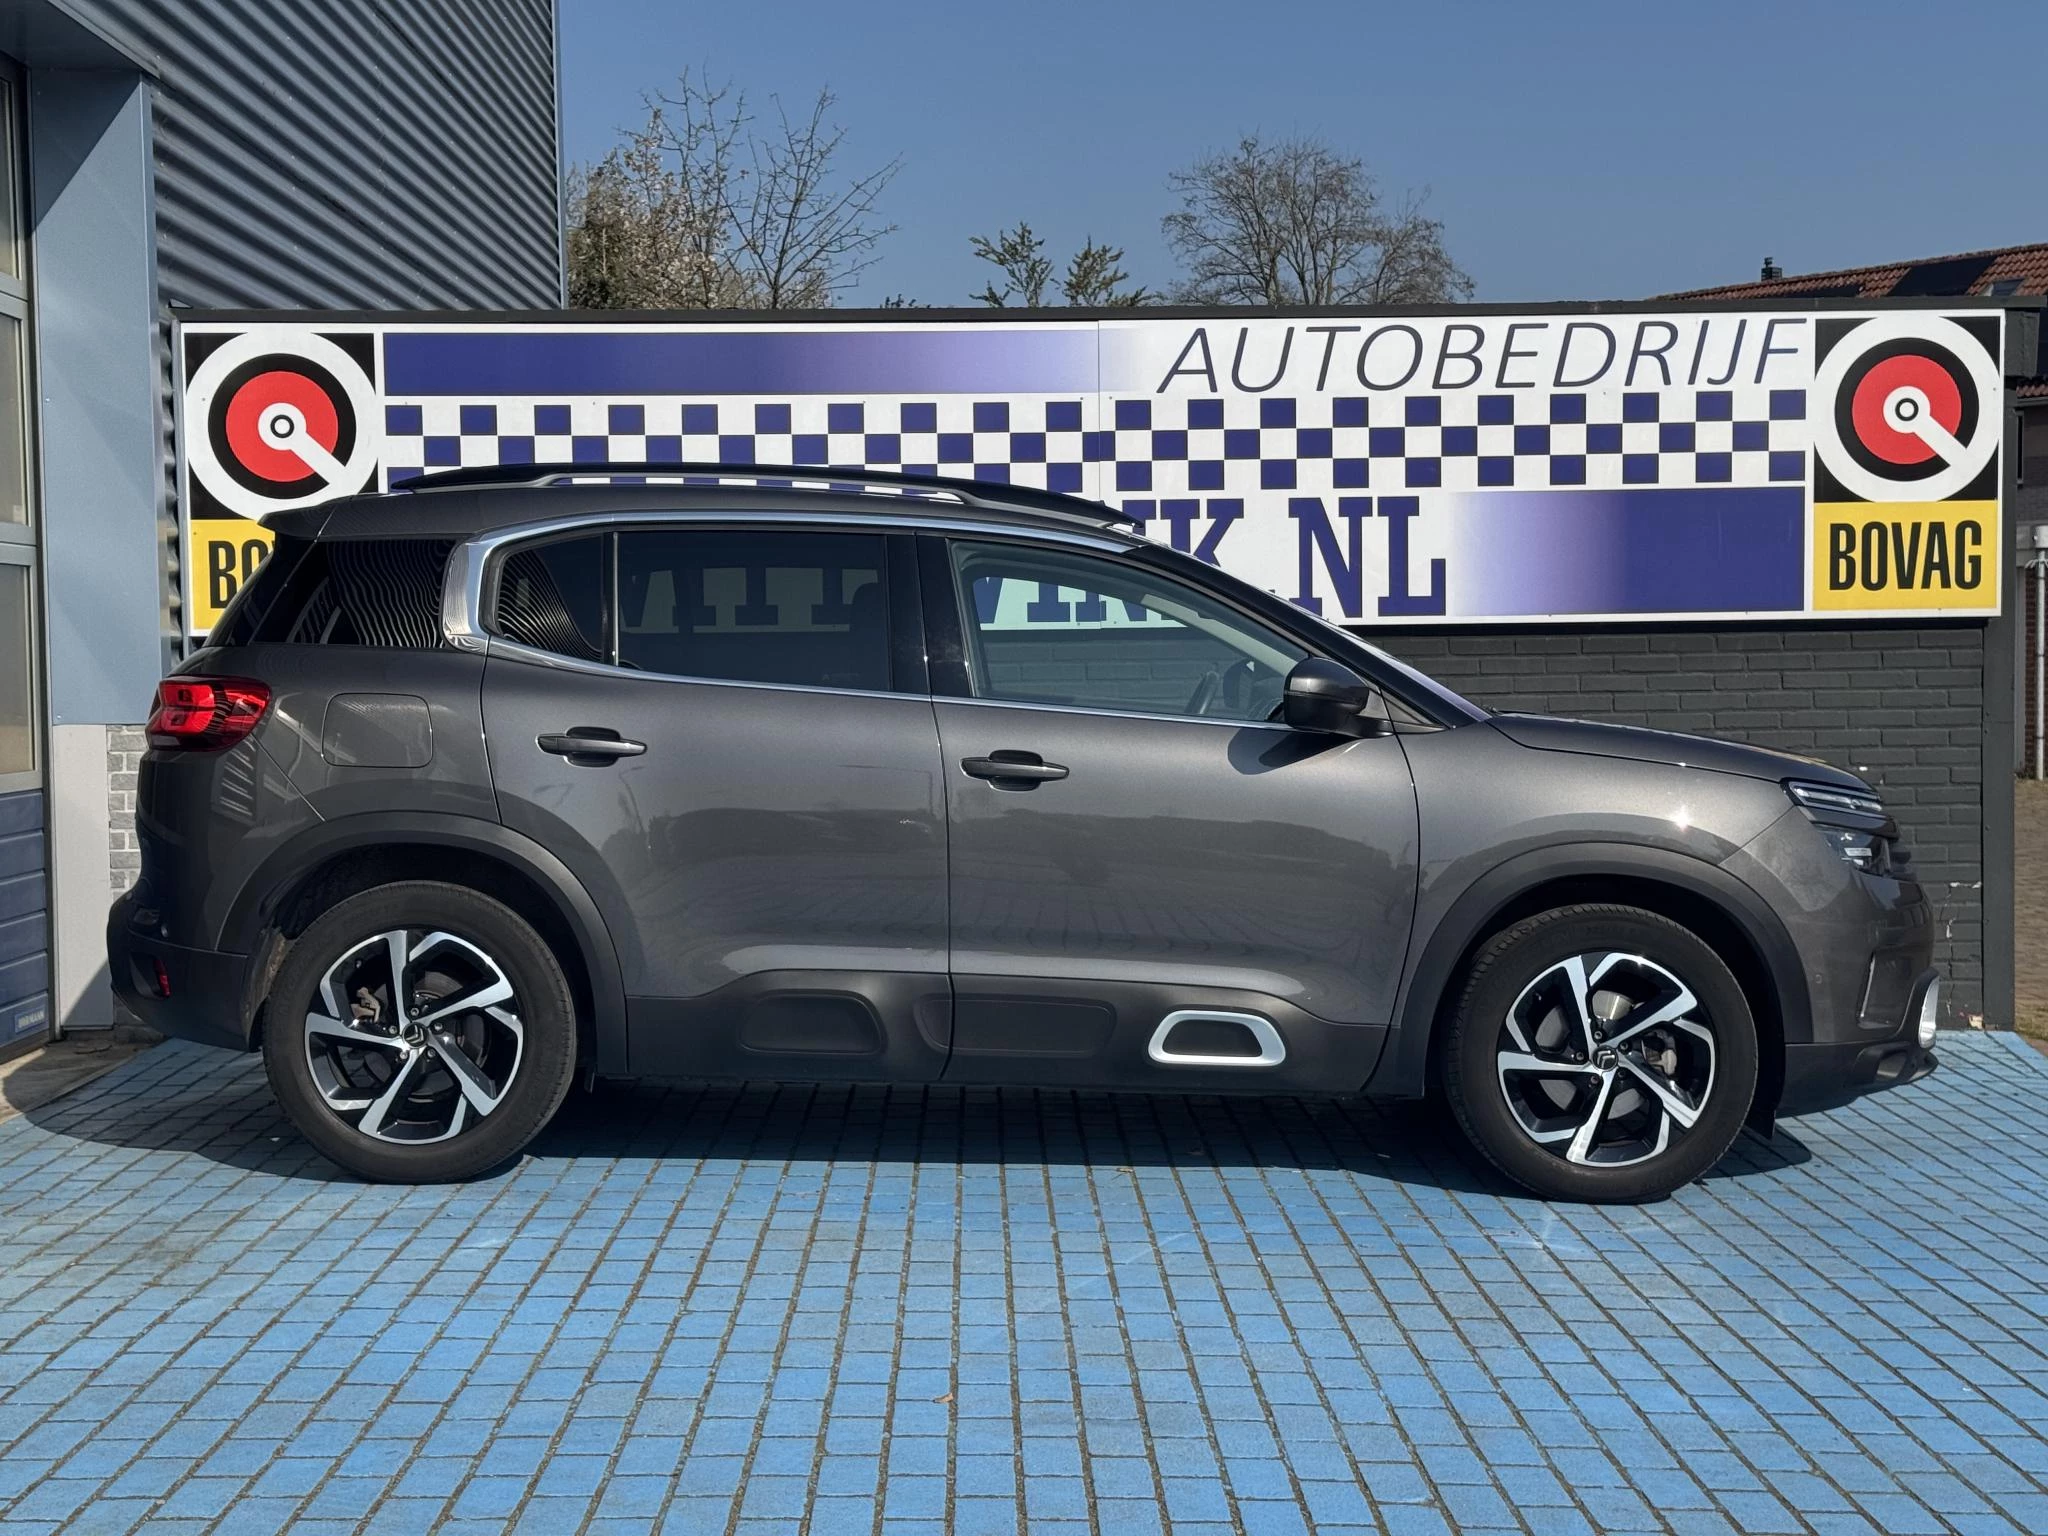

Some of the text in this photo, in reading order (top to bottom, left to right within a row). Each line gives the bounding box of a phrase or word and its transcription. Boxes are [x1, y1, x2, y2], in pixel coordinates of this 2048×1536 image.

[1156, 318, 1807, 393] AUTOBEDRIJF
[208, 539, 275, 608] BO
[1829, 520, 1982, 591] BOVAG
